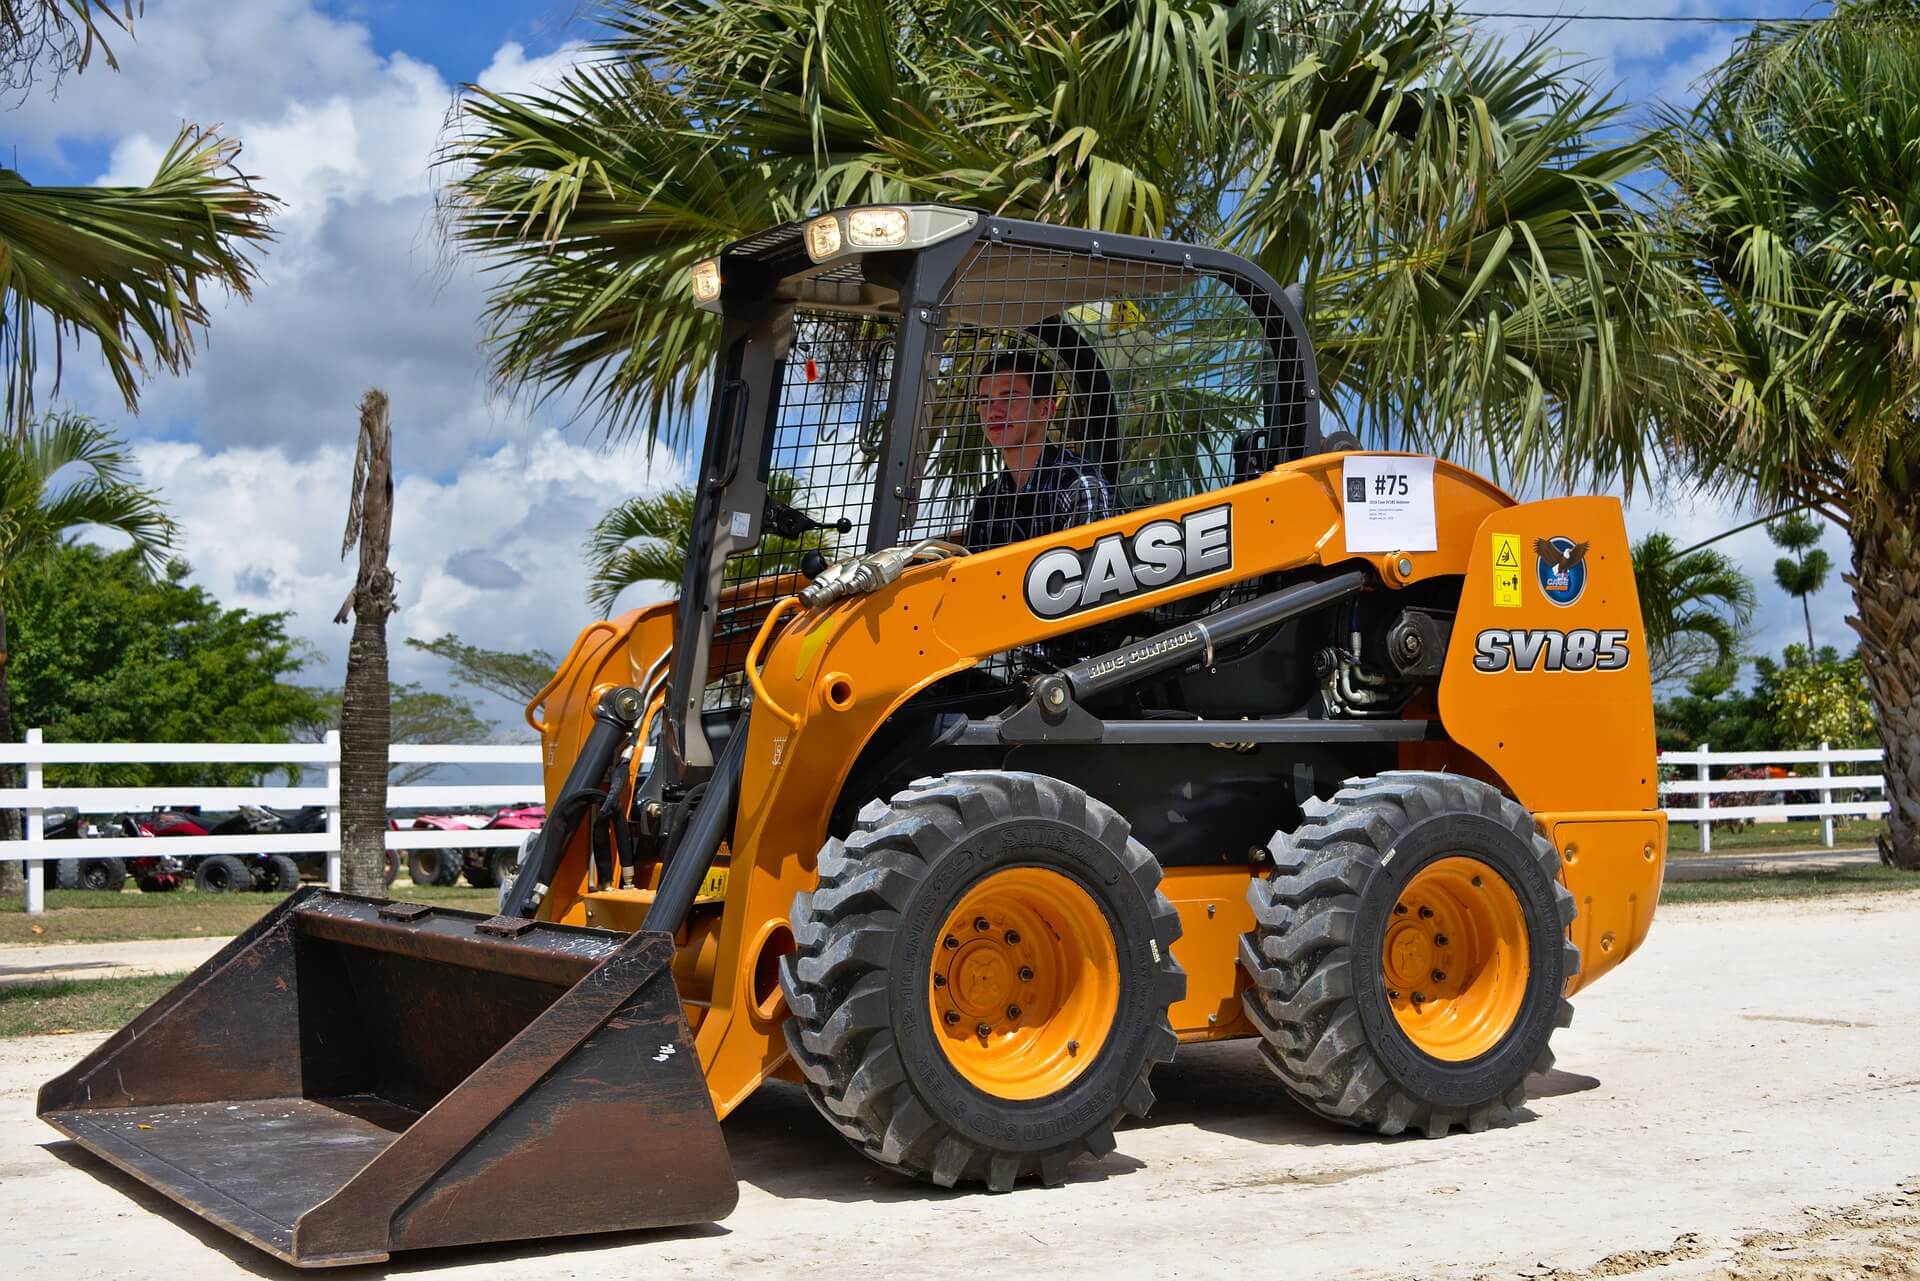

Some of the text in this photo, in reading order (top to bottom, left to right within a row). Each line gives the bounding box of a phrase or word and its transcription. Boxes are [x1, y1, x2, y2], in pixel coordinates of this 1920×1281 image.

[1375, 475, 1408, 495] #75
[1023, 504, 1232, 618] CASE
[1088, 631, 1198, 678] RIDE CONTROL
[1473, 629, 1630, 672] SV185
